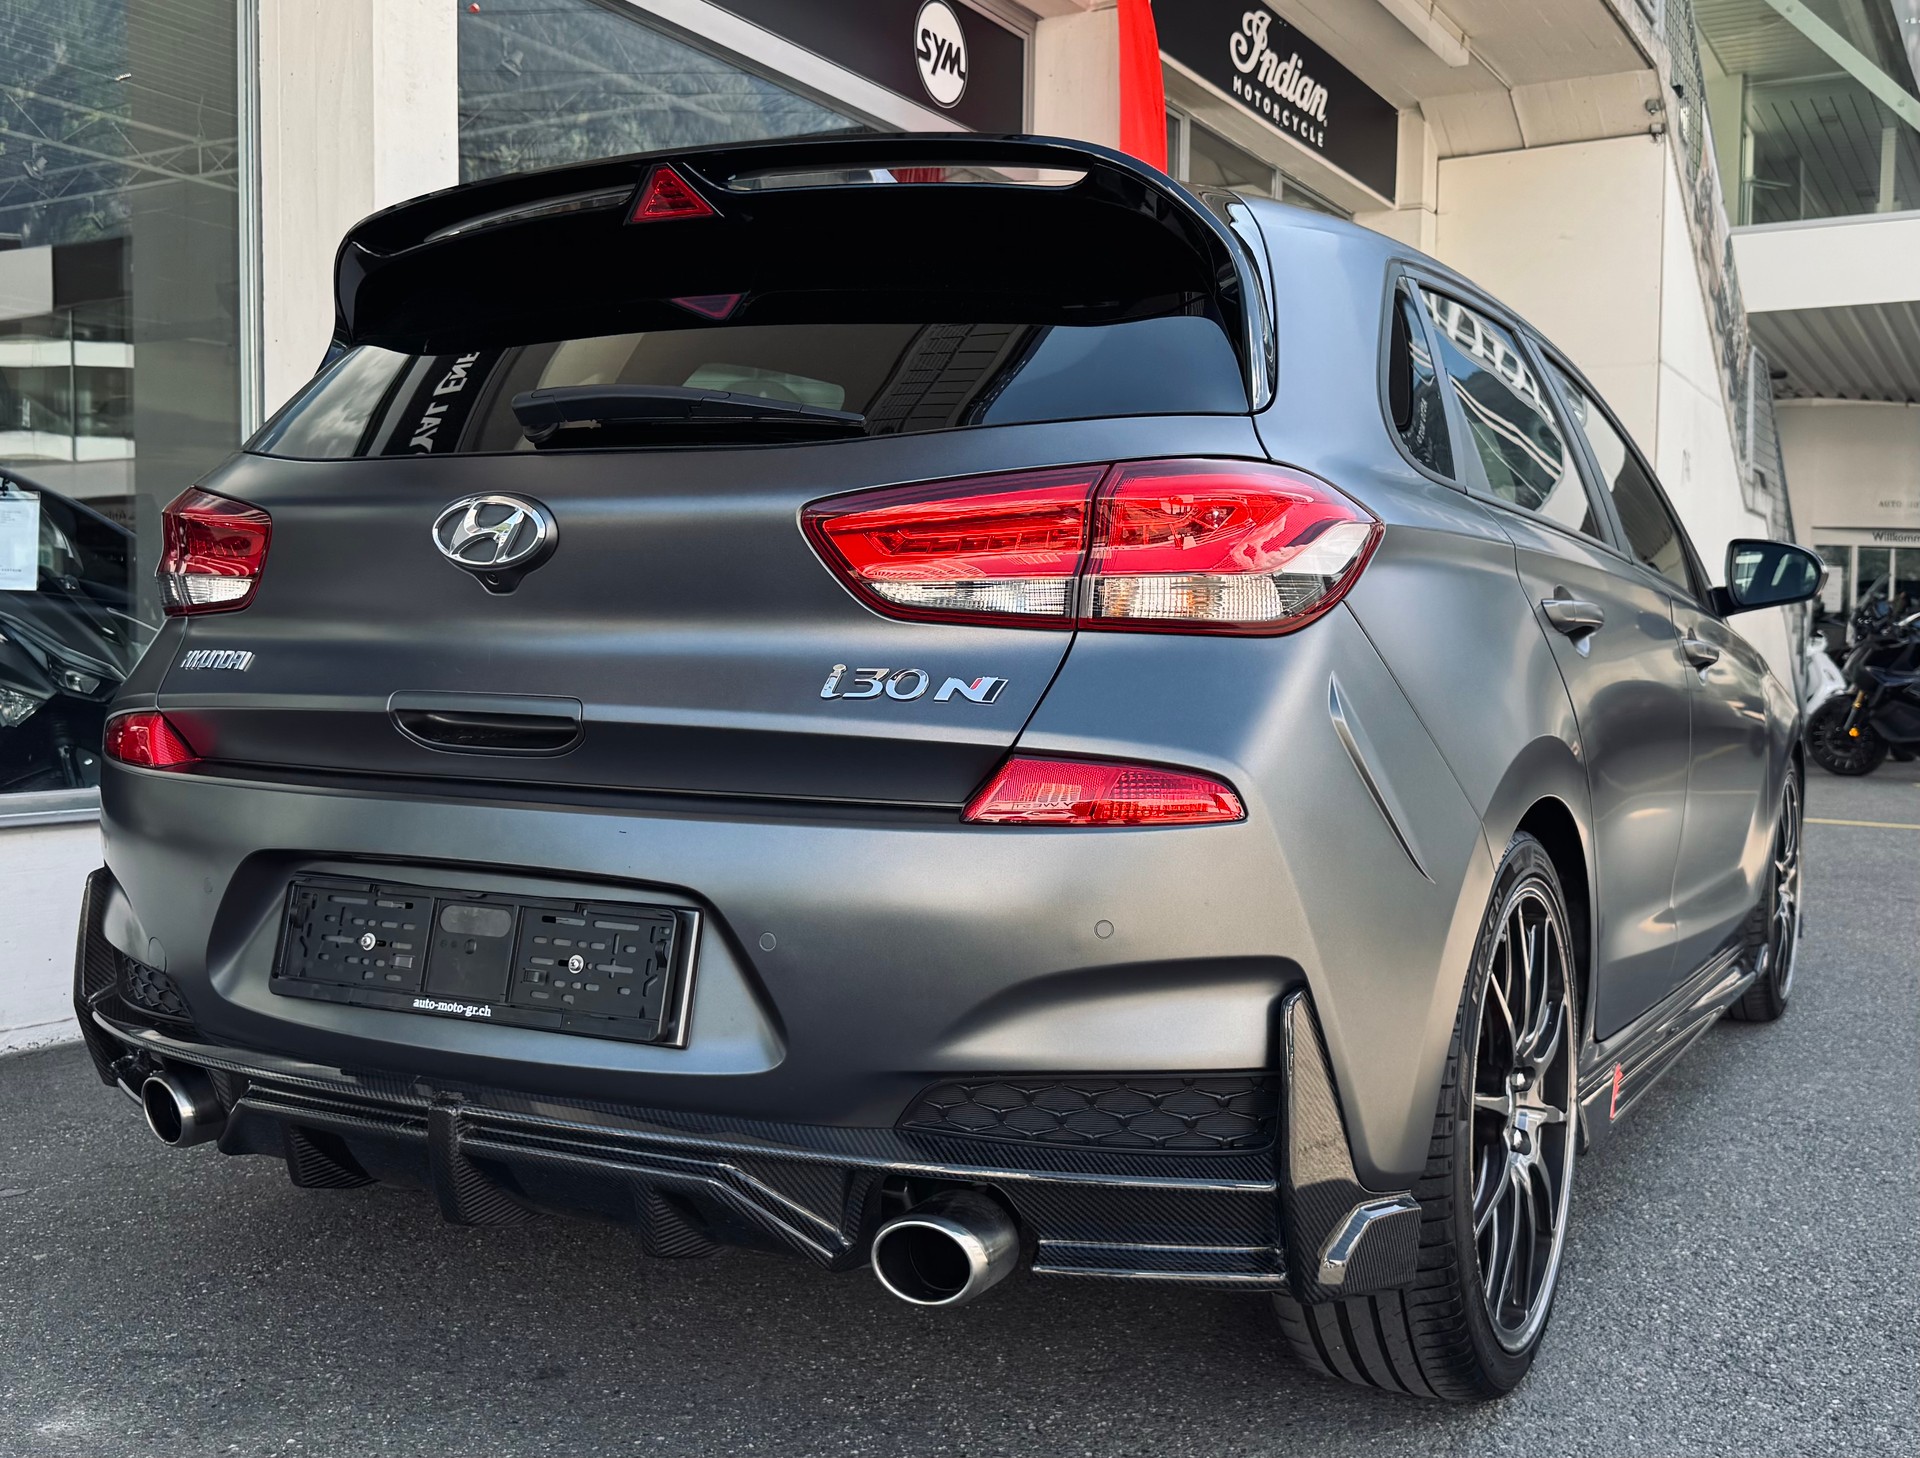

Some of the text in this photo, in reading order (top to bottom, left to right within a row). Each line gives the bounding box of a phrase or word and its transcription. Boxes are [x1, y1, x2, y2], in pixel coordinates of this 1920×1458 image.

[916, 28, 966, 81] SYM
[1229, 10, 1329, 122] Indian
[1232, 74, 1325, 148] MOTORCYCLE
[820, 663, 1009, 705] i30 N
[1471, 886, 1504, 1005] NEXEN
[412, 997, 492, 1017] auto-moto-gr.ch
